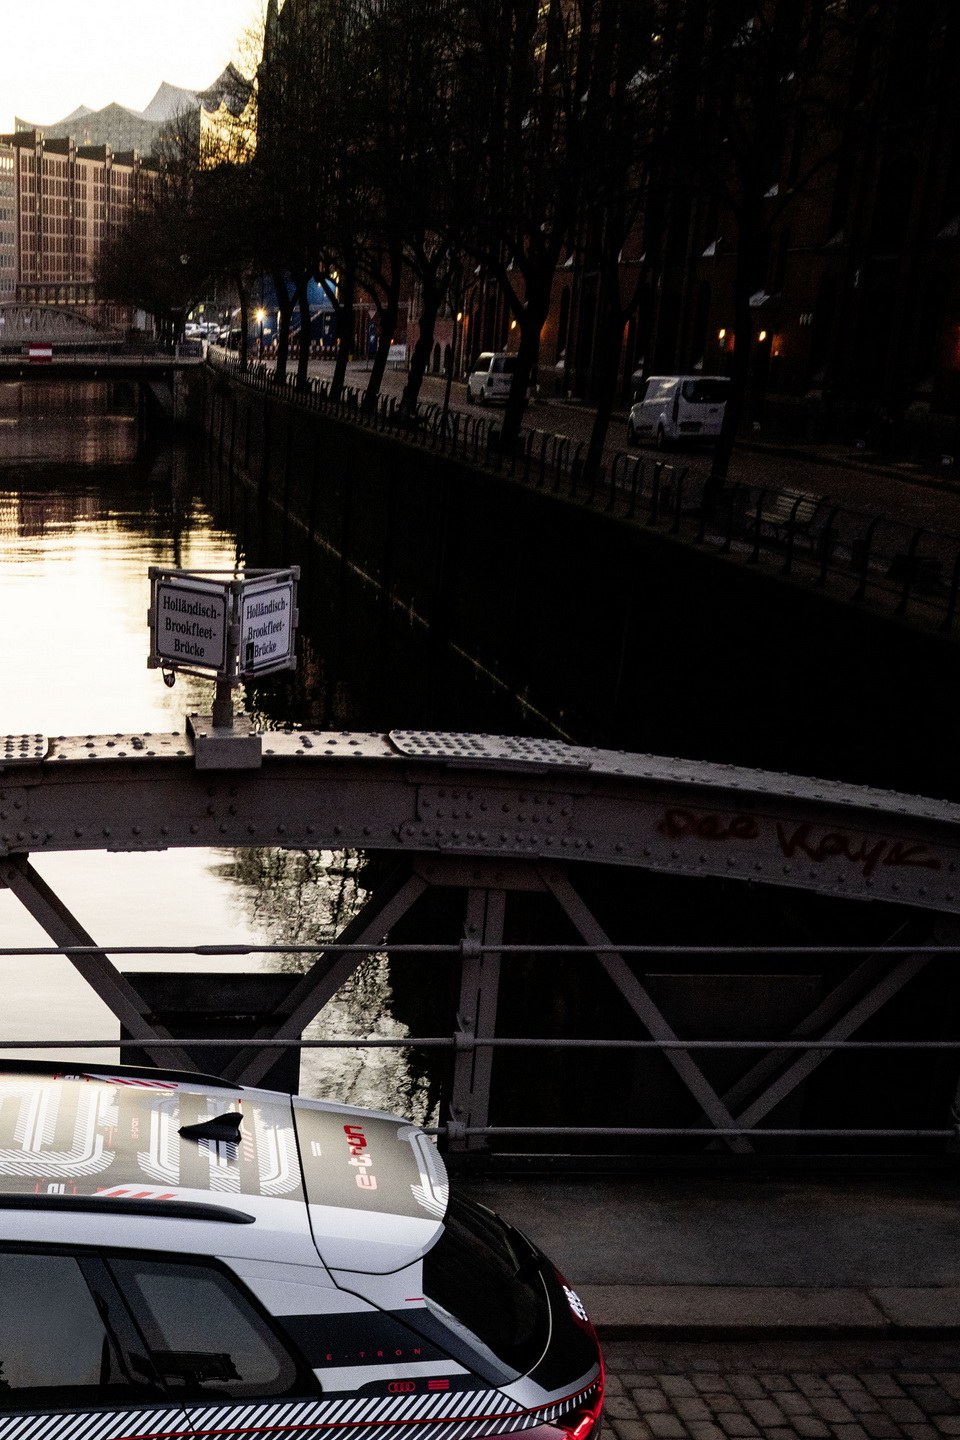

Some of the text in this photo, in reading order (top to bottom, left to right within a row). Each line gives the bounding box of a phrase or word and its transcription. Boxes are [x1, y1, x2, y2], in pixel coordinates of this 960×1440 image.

[163, 595, 221, 619] Holländisch-
[246, 597, 288, 620] Holländisch-
[165, 617, 216, 640] Brookfleet-
[248, 621, 285, 641] Brookfleet-
[174, 638, 205, 657] Brücke
[254, 641, 277, 658] Brücke
[343, 1125, 378, 1190] e-tron
